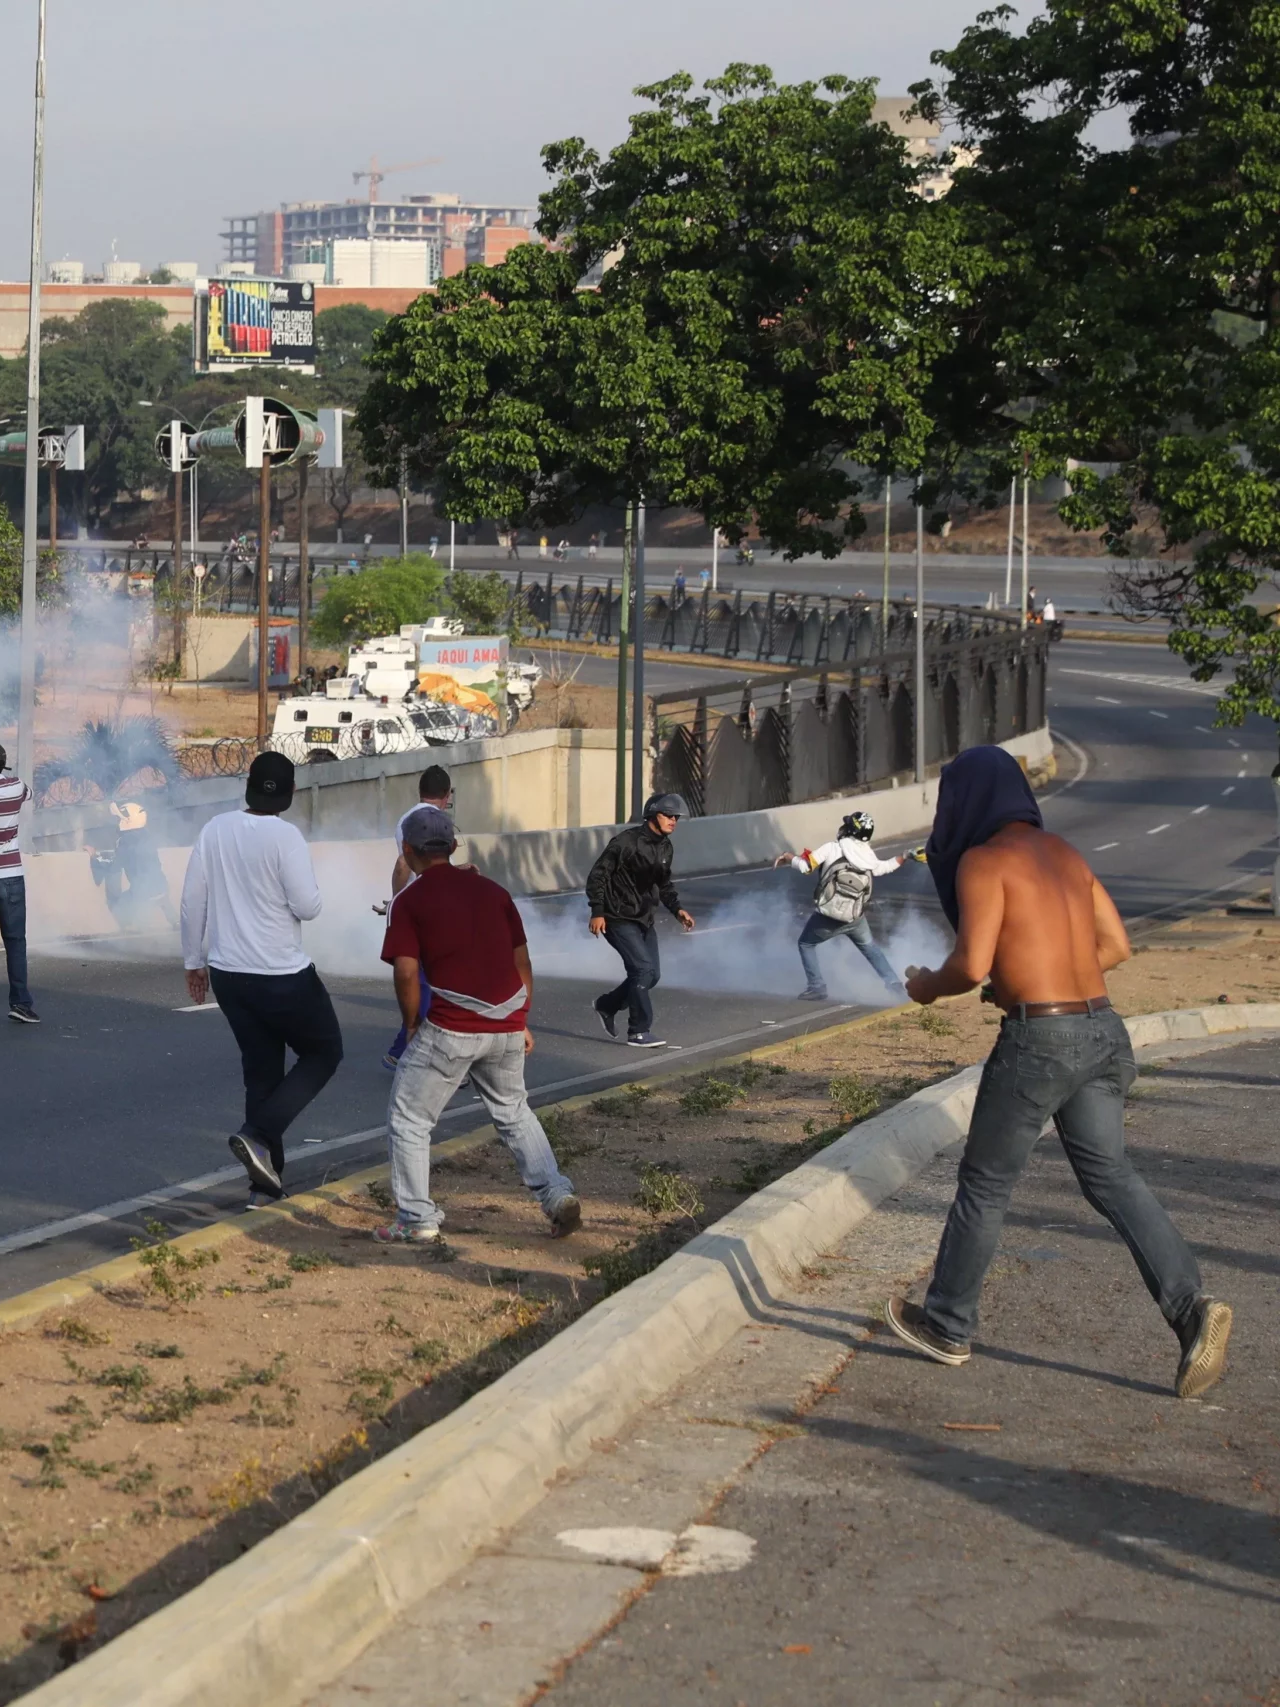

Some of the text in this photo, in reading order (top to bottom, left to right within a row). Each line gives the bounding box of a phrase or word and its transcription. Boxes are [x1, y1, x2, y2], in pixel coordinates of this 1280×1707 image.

[271, 307, 313, 322] ÚNICO DINERO
[272, 321, 313, 333] CON RESPALDO
[271, 332, 313, 346] PETROLERO
[311, 728, 333, 742] GNB
